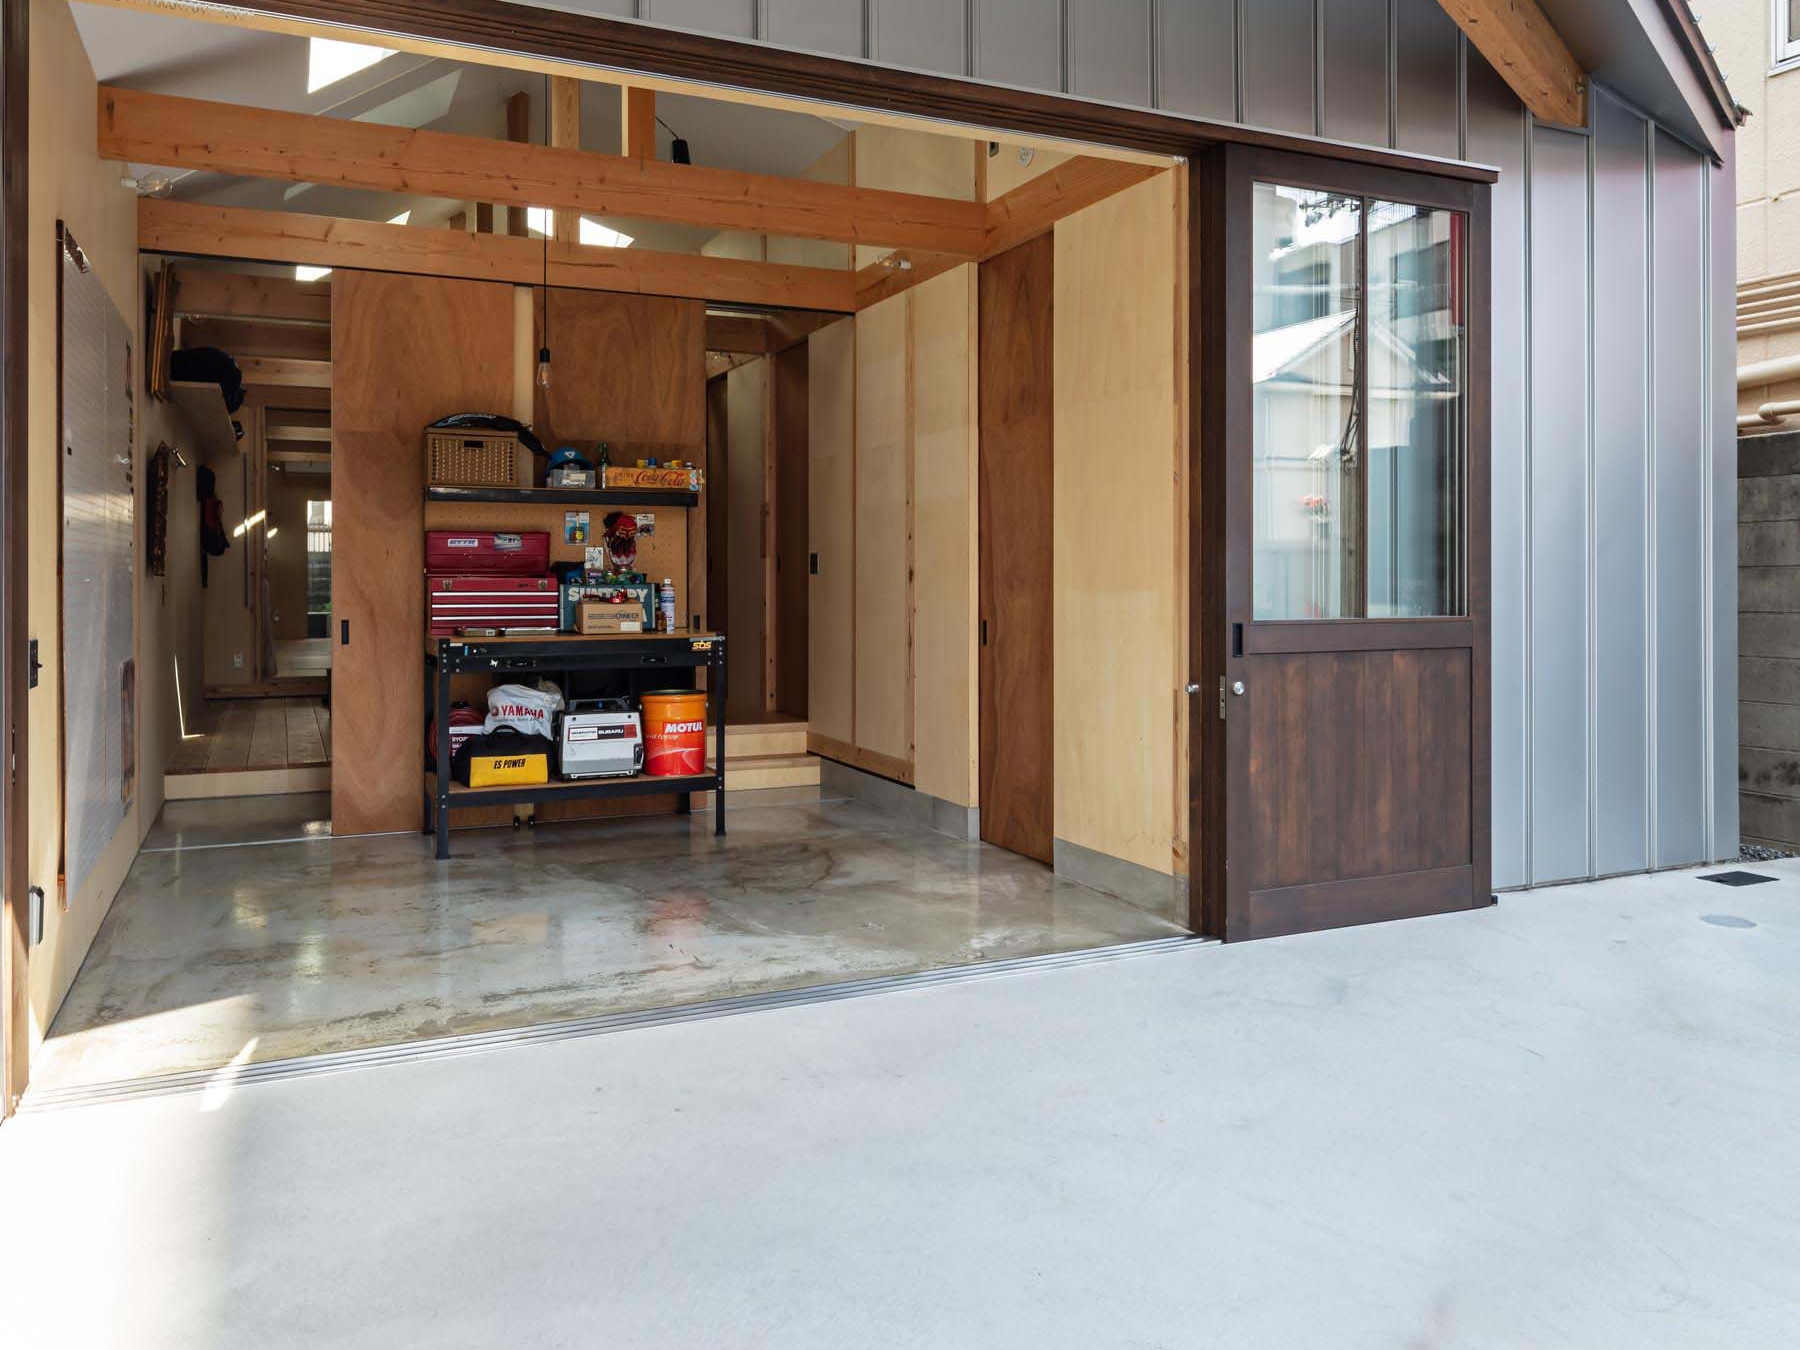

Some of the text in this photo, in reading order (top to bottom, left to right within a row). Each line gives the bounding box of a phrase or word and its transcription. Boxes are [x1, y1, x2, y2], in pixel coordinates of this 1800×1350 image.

[568, 587, 649, 603] SUNTRY
[692, 640, 712, 649] sbs
[501, 705, 544, 719] YAMAHA
[665, 721, 703, 733] MOTUL
[493, 758, 526, 769] ES POWER
